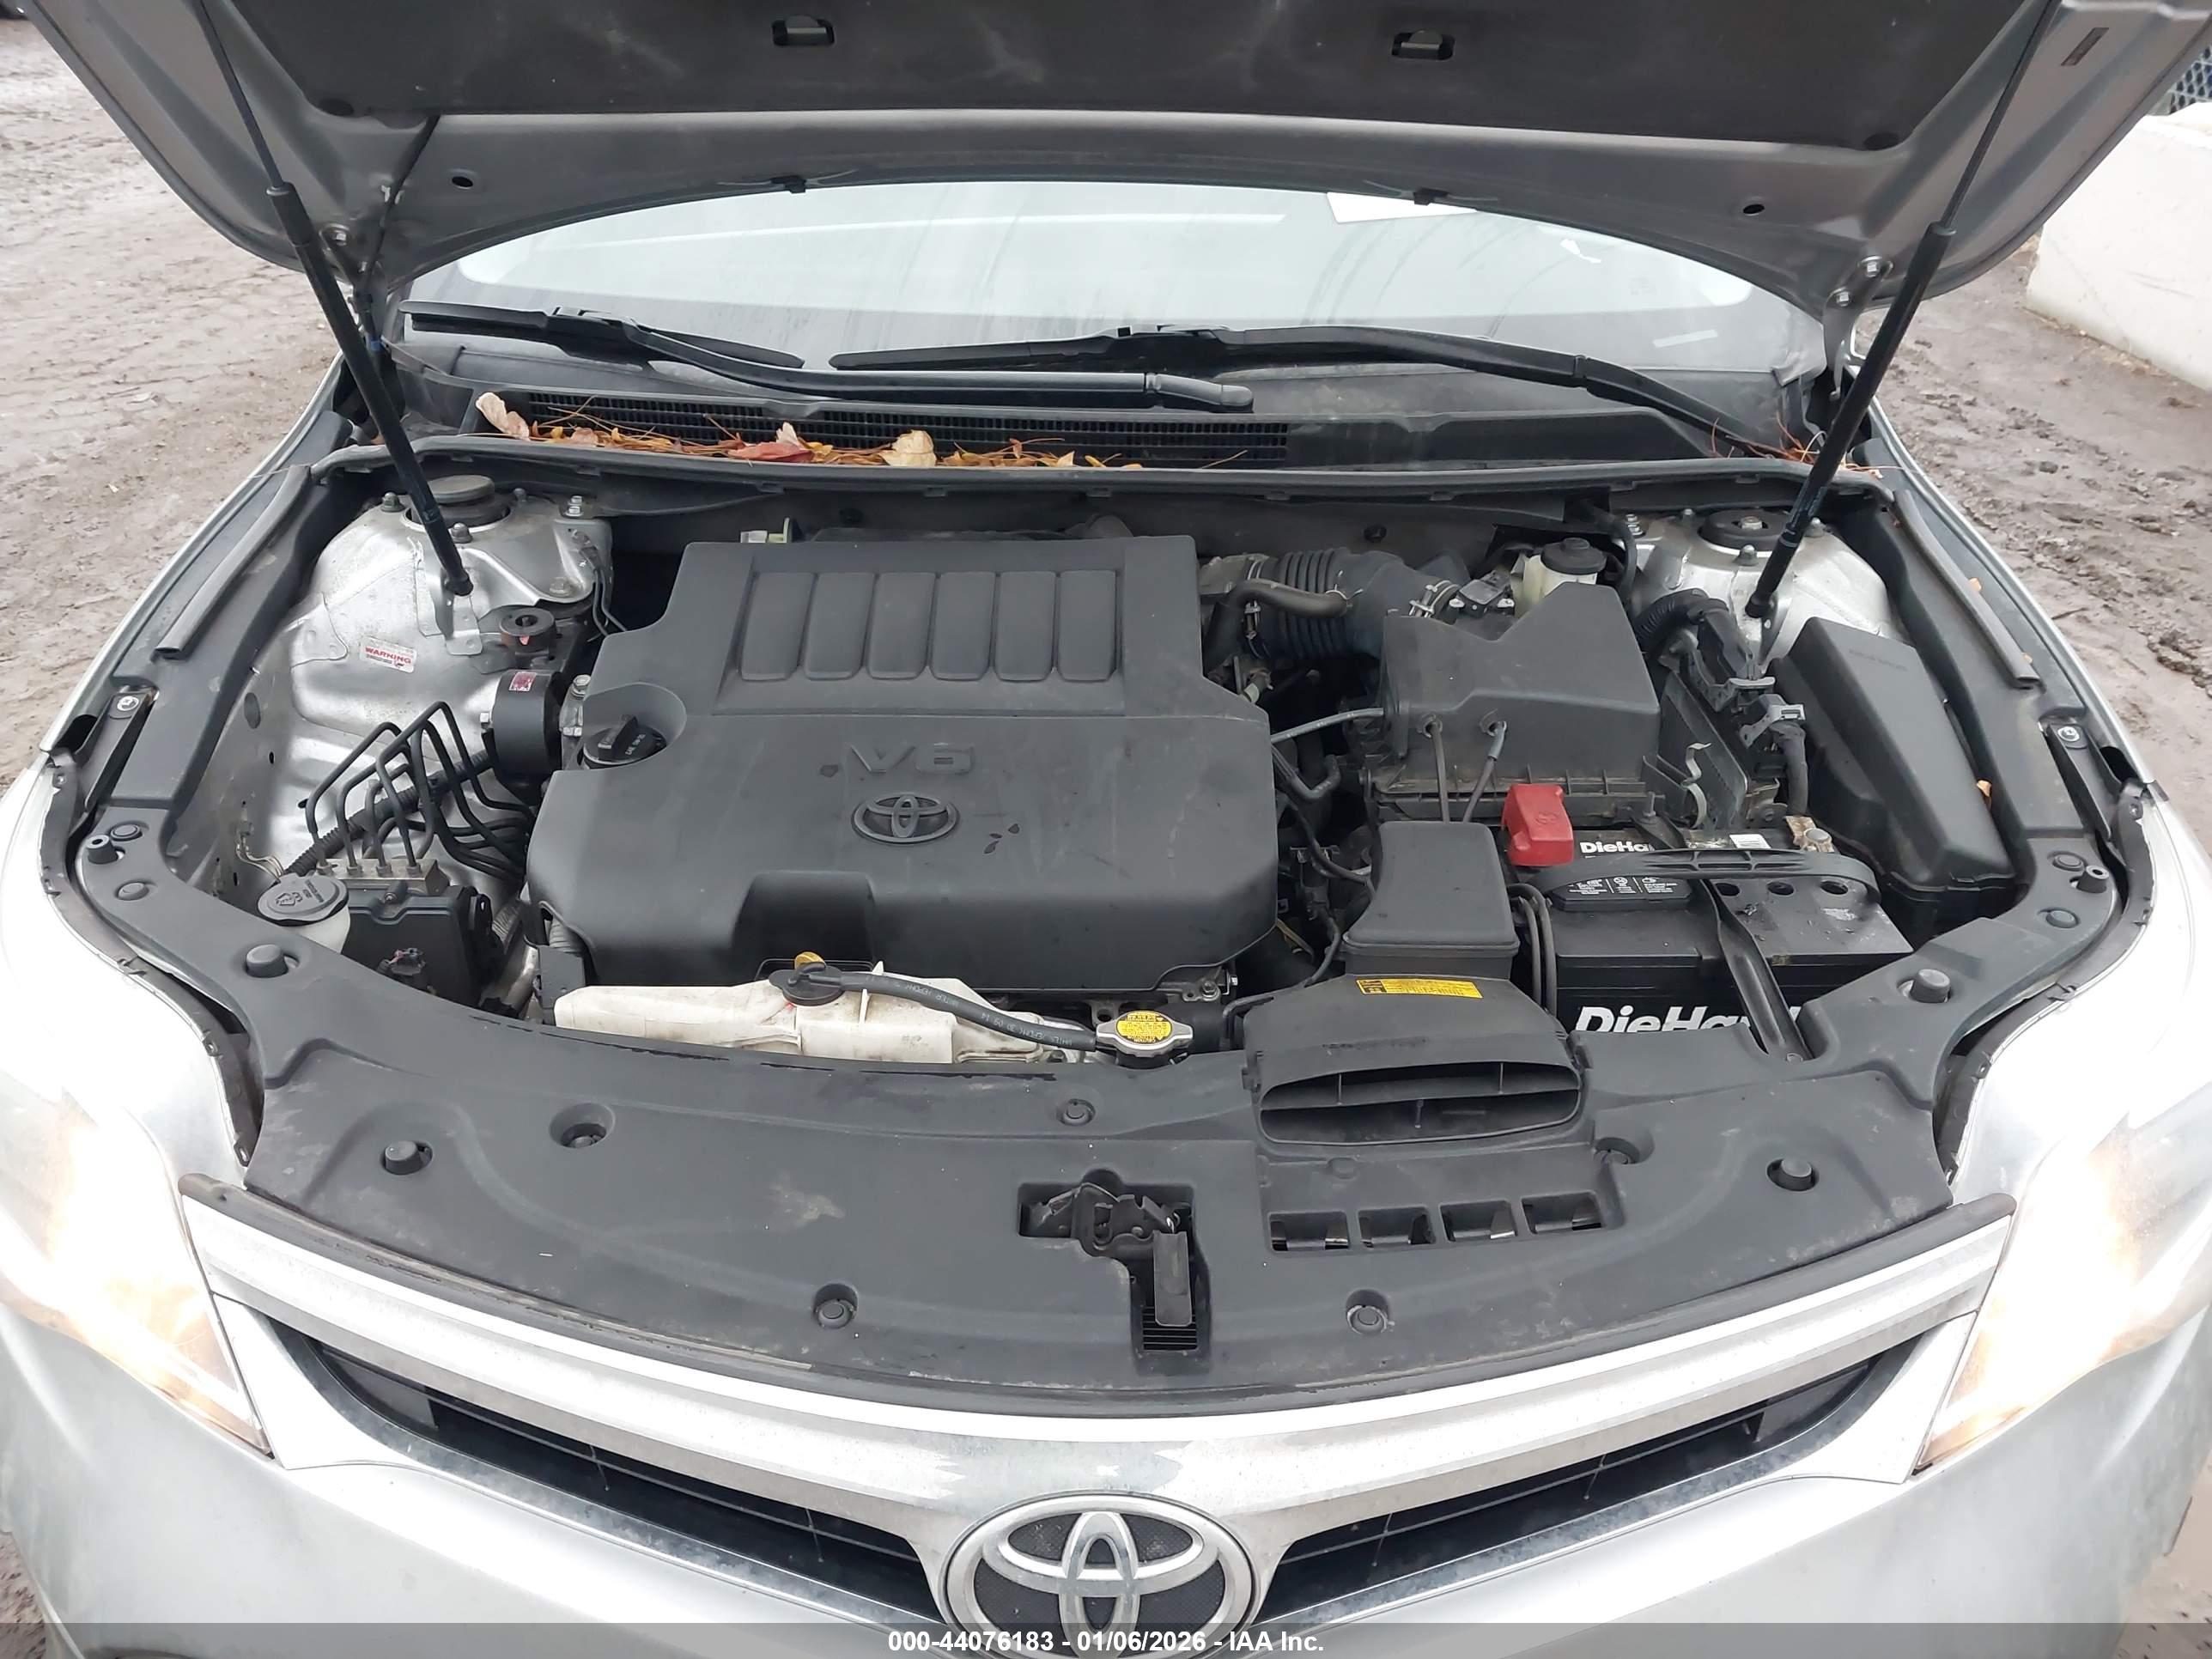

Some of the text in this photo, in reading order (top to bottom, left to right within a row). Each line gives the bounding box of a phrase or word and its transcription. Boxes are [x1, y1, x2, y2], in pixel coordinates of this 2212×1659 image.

[365, 646, 411, 664] WARNING
[849, 742, 975, 775] V6
[1579, 841, 1654, 854] DieHa
